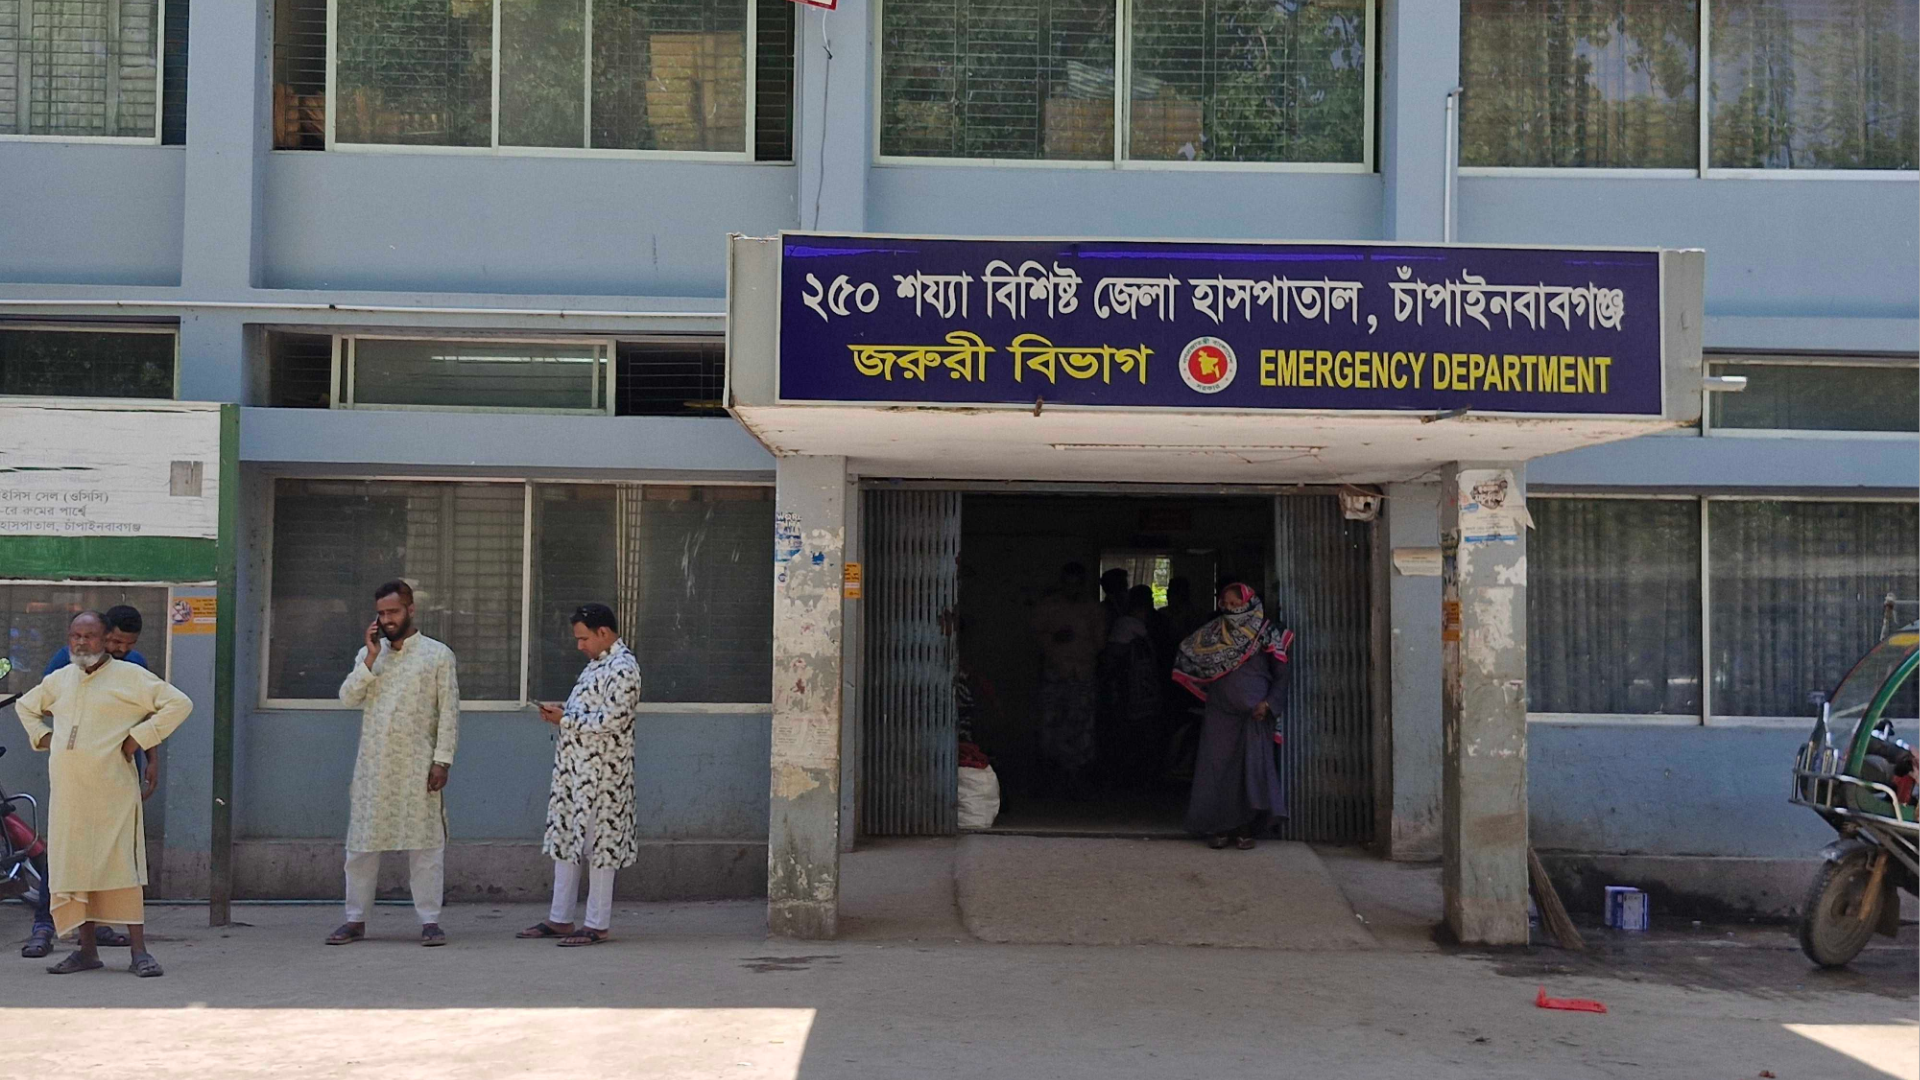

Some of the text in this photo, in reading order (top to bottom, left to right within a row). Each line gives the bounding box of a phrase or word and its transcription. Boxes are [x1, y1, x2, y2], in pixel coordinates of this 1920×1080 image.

[803, 260, 1624, 334] ২৫০ শয্যা বিশিষ্ট জেলা হাসপাতাল, চাঁপাইনবাবগঞ্জ
[848, 331, 1154, 384] জরুরী বিভাগ
[1260, 349, 1612, 393] EMERGENCY DEPARTMENT
[35, 491, 59, 501] সেল
